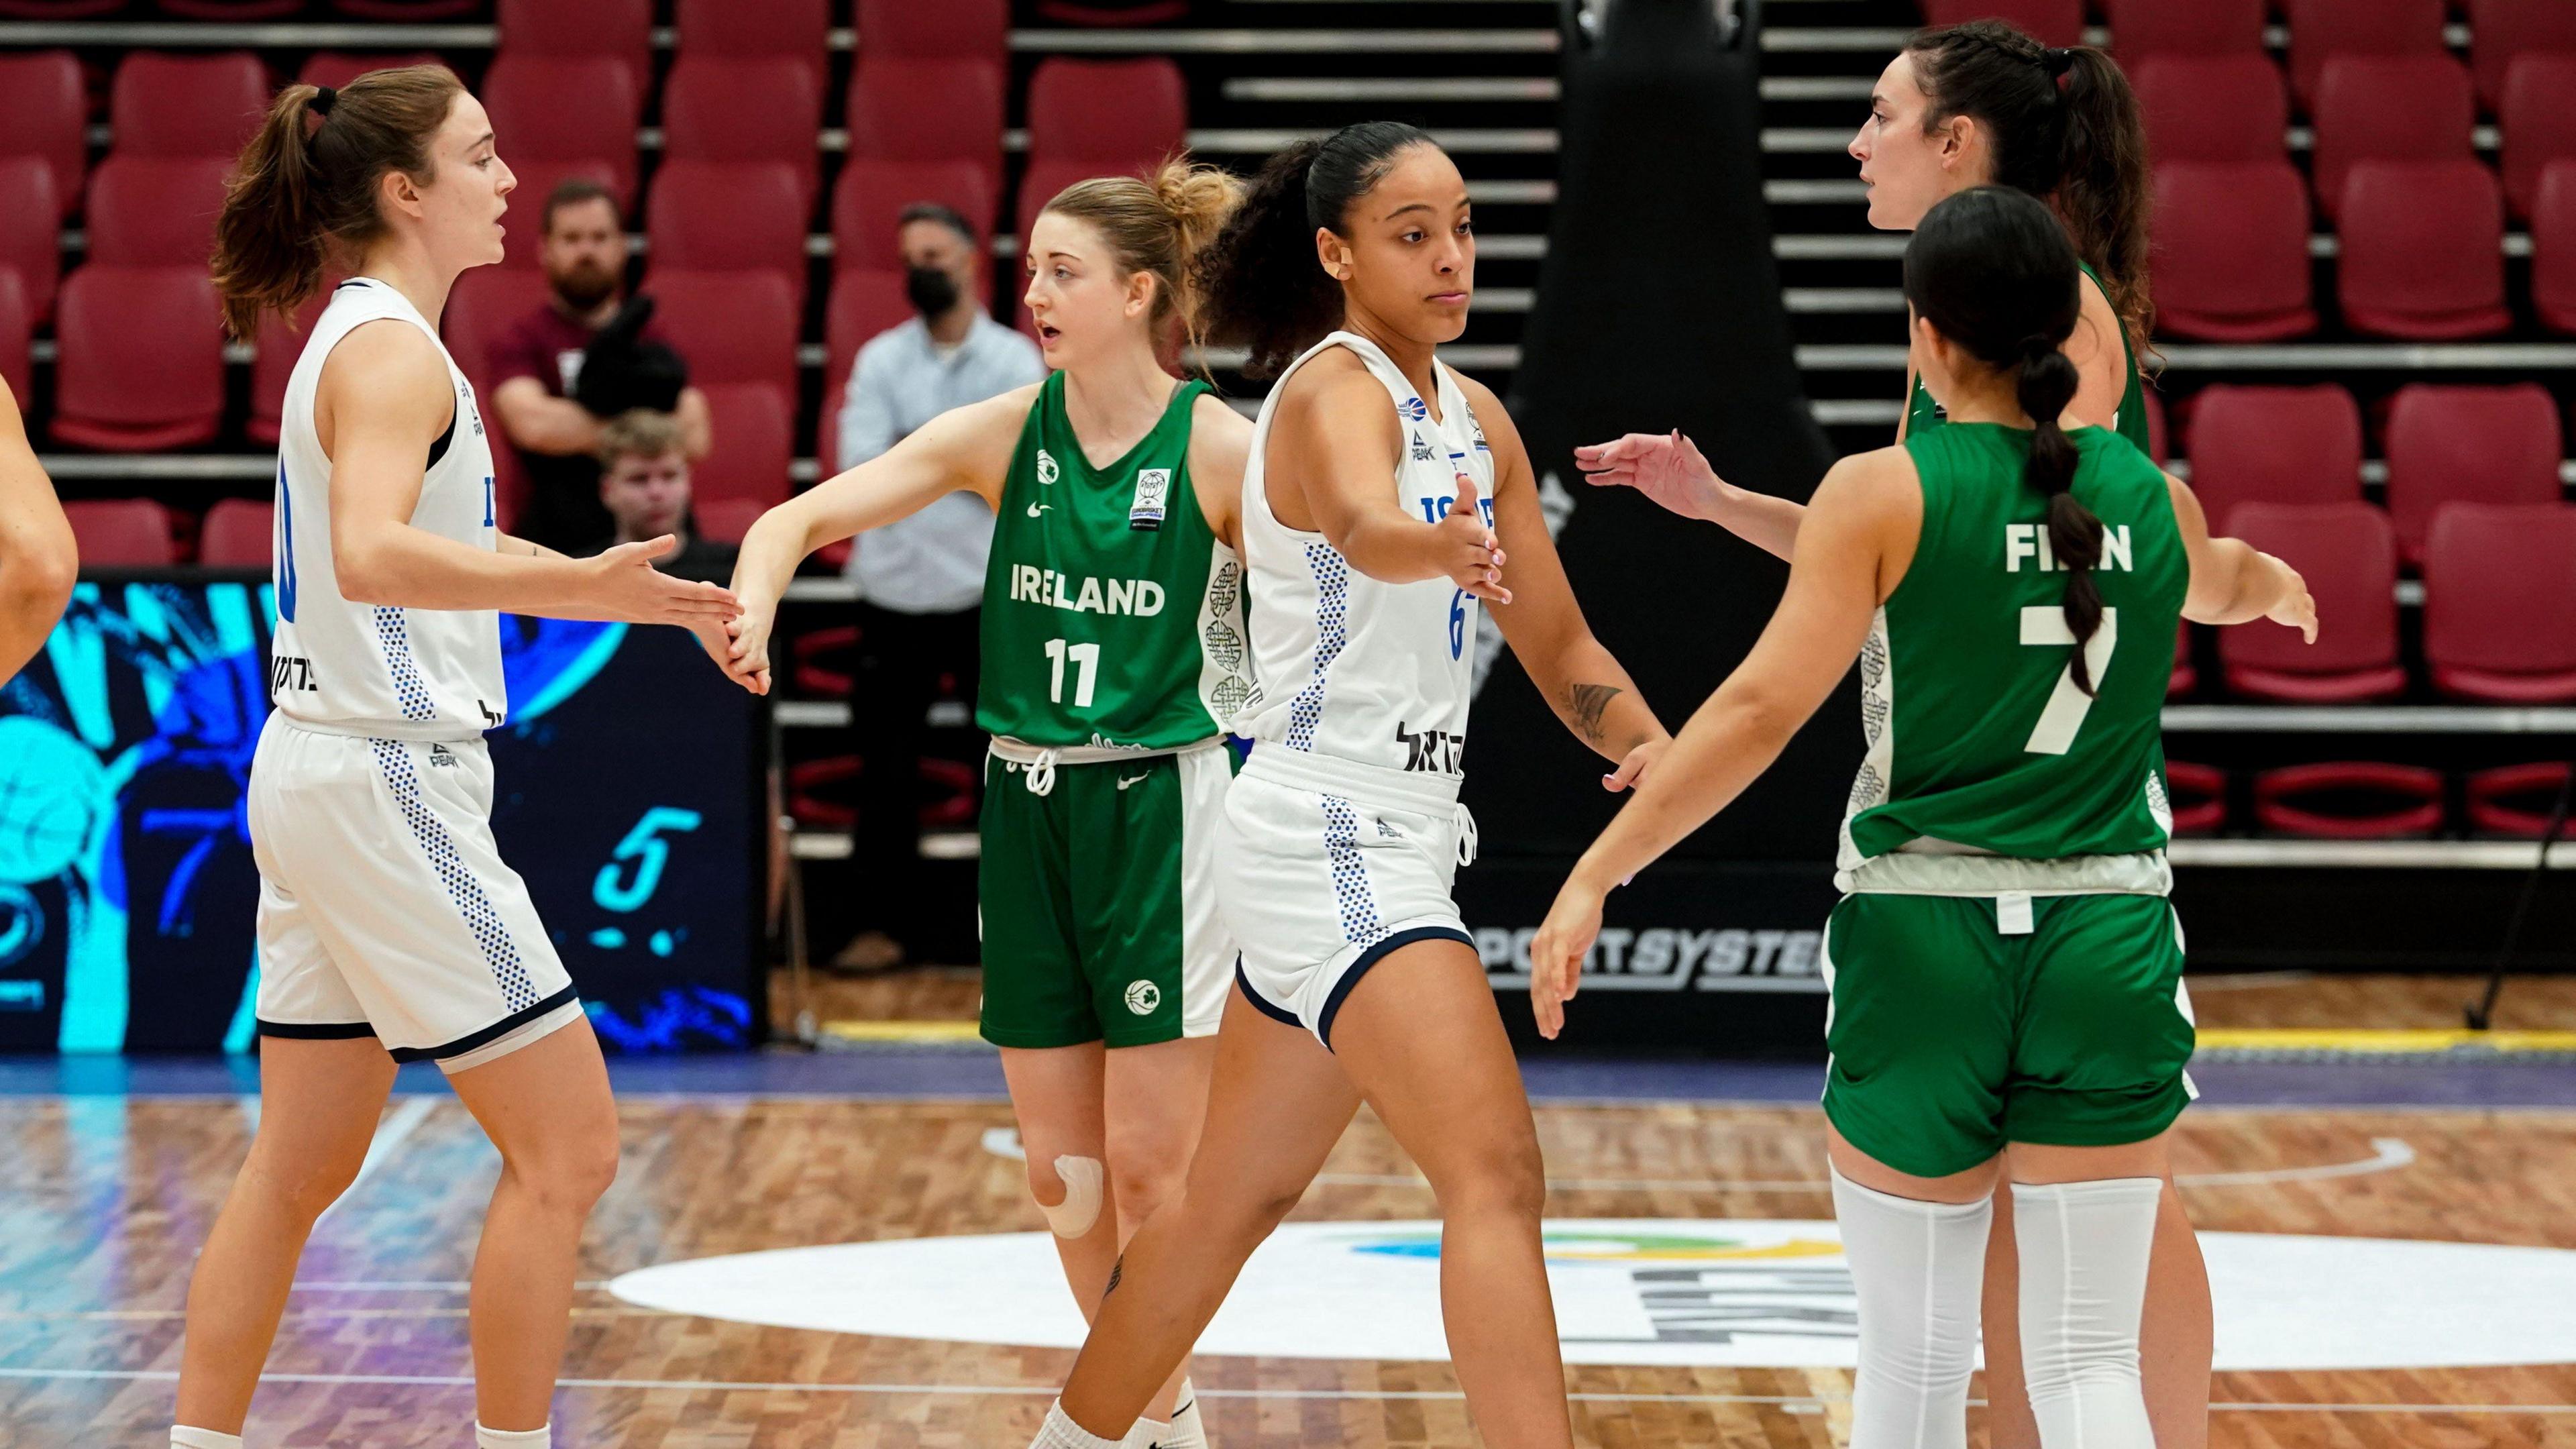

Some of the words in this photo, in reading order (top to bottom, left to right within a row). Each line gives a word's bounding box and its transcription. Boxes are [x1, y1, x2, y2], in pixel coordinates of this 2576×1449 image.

[1412, 446, 1436, 461] PEAK
[2006, 523, 2133, 572] FIN
[1010, 564, 1165, 616] IRELAND
[1044, 639, 1100, 708] 11
[2020, 606, 2116, 755] 7
[429, 755, 459, 768] PEAK
[592, 806, 702, 913] 5
